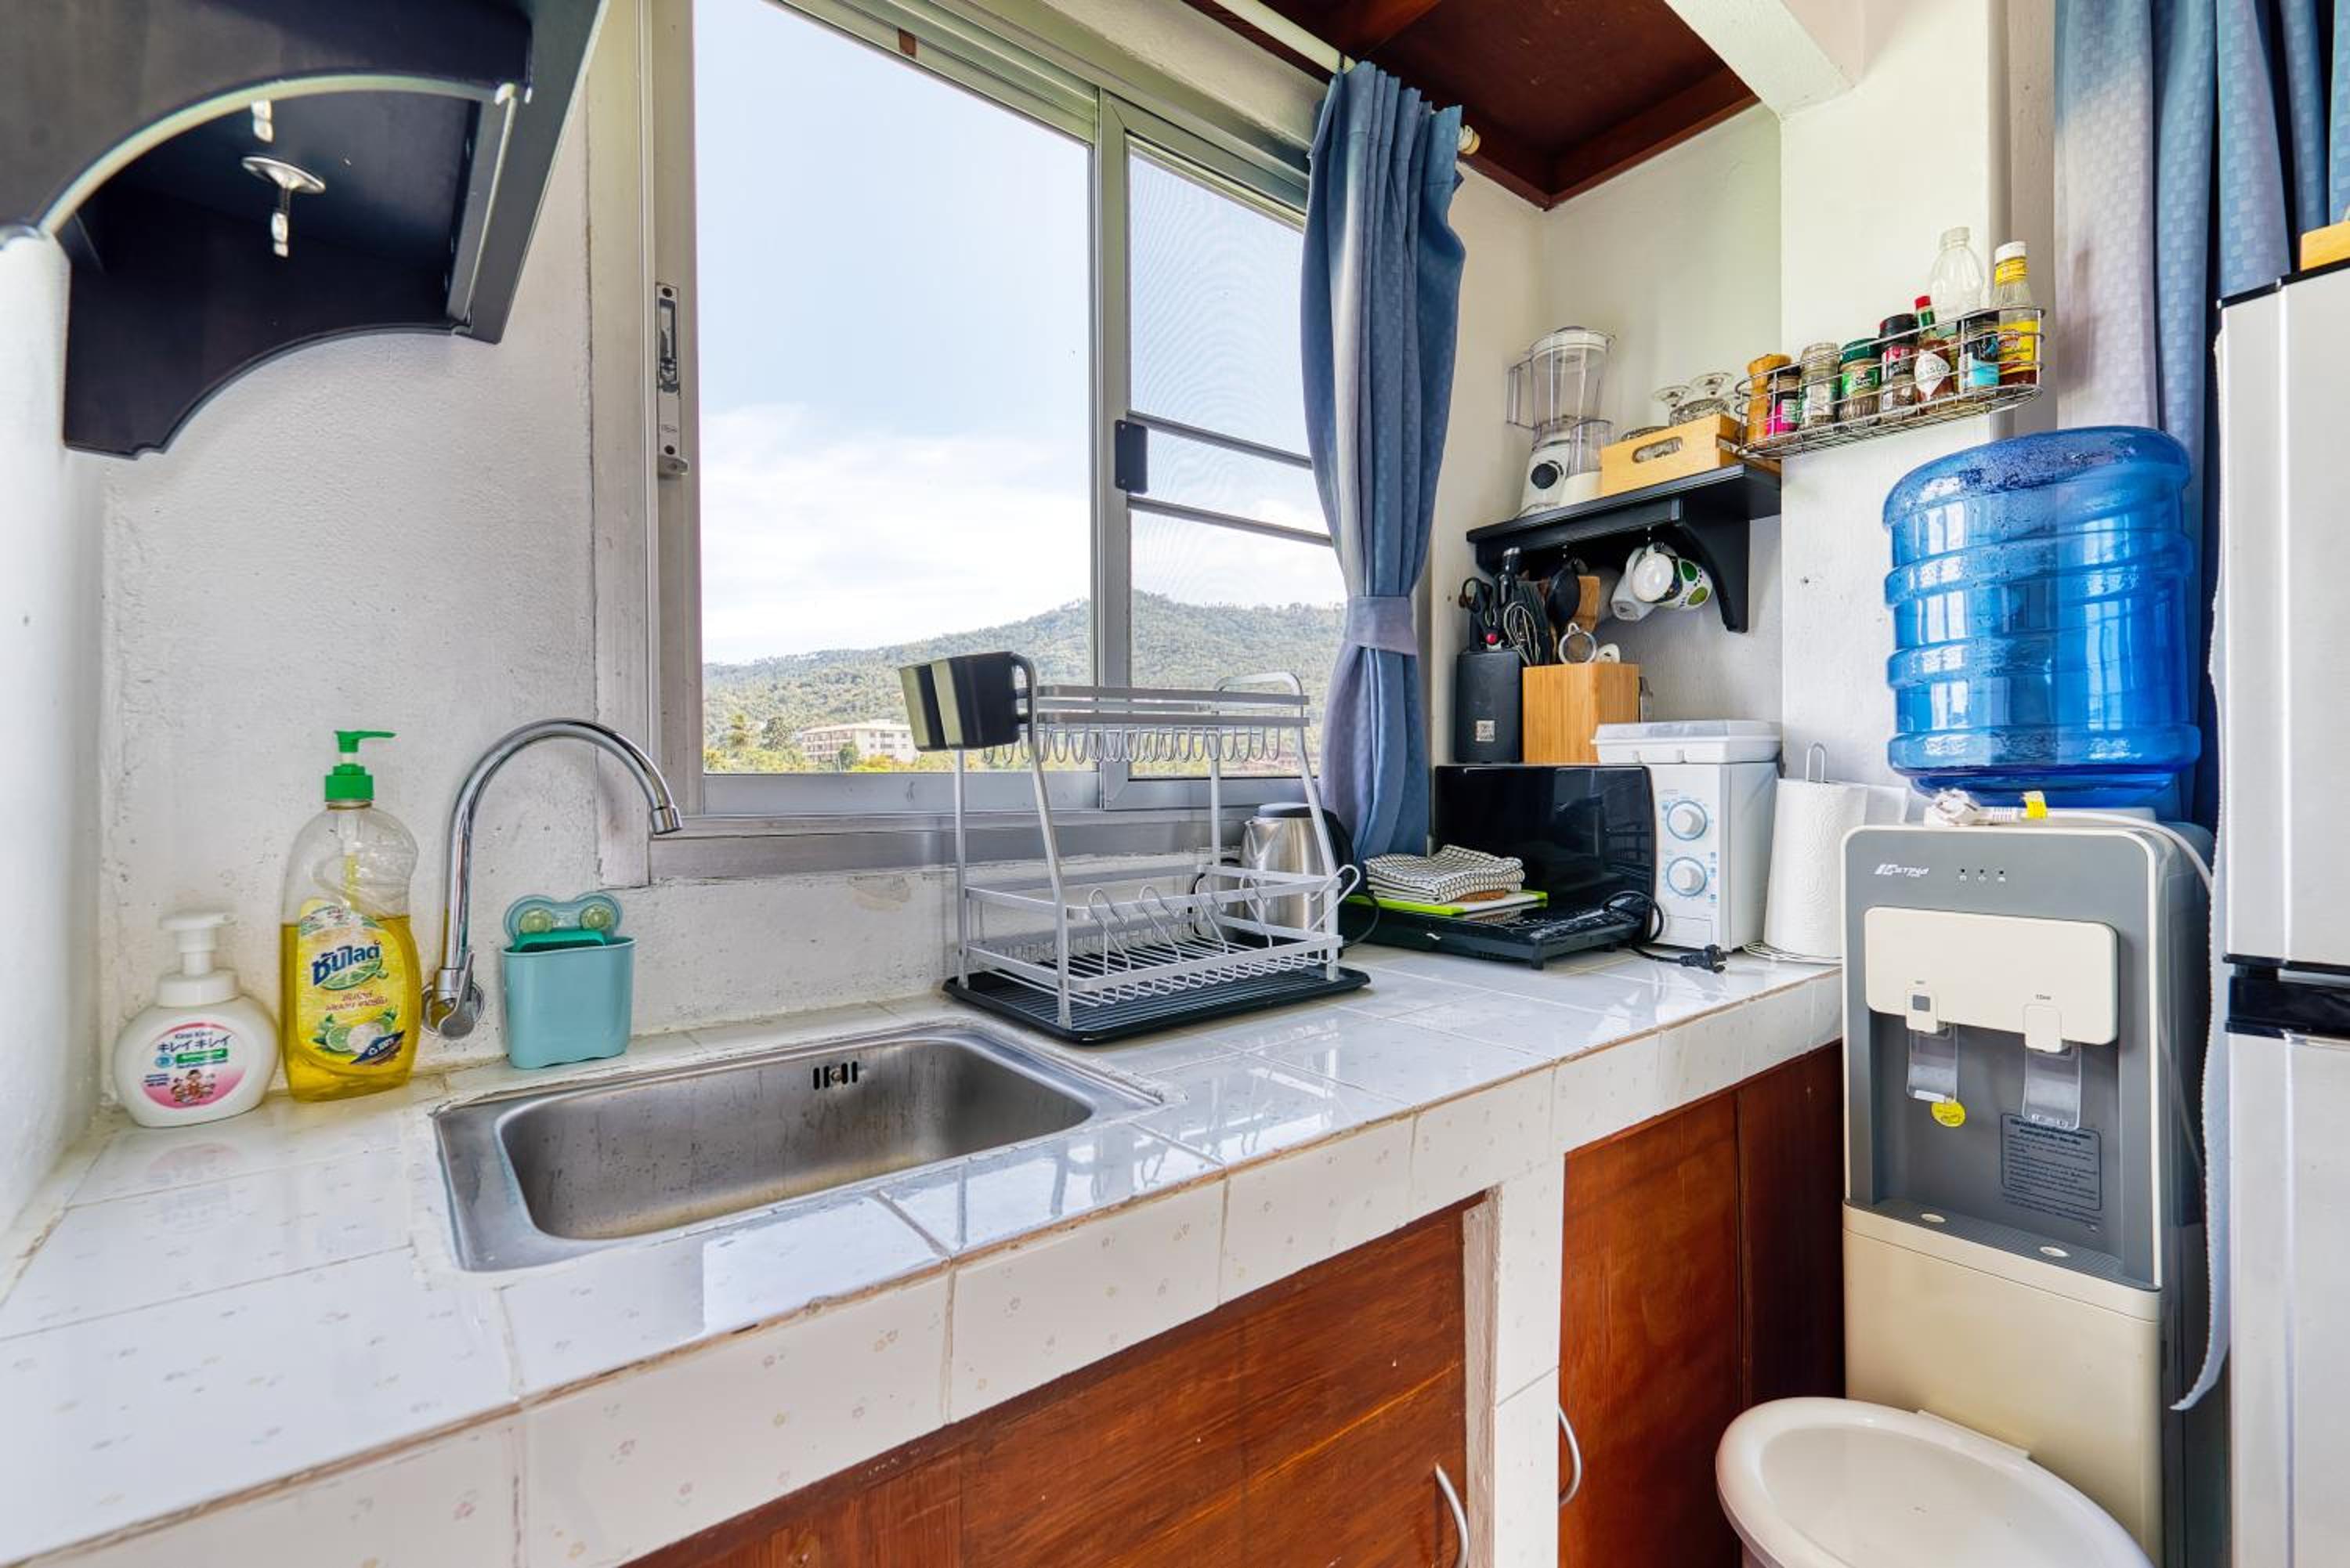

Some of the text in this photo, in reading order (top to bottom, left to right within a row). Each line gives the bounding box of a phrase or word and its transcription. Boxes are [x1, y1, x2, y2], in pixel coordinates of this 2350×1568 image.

[157, 1035, 231, 1053] キレイキレイ
